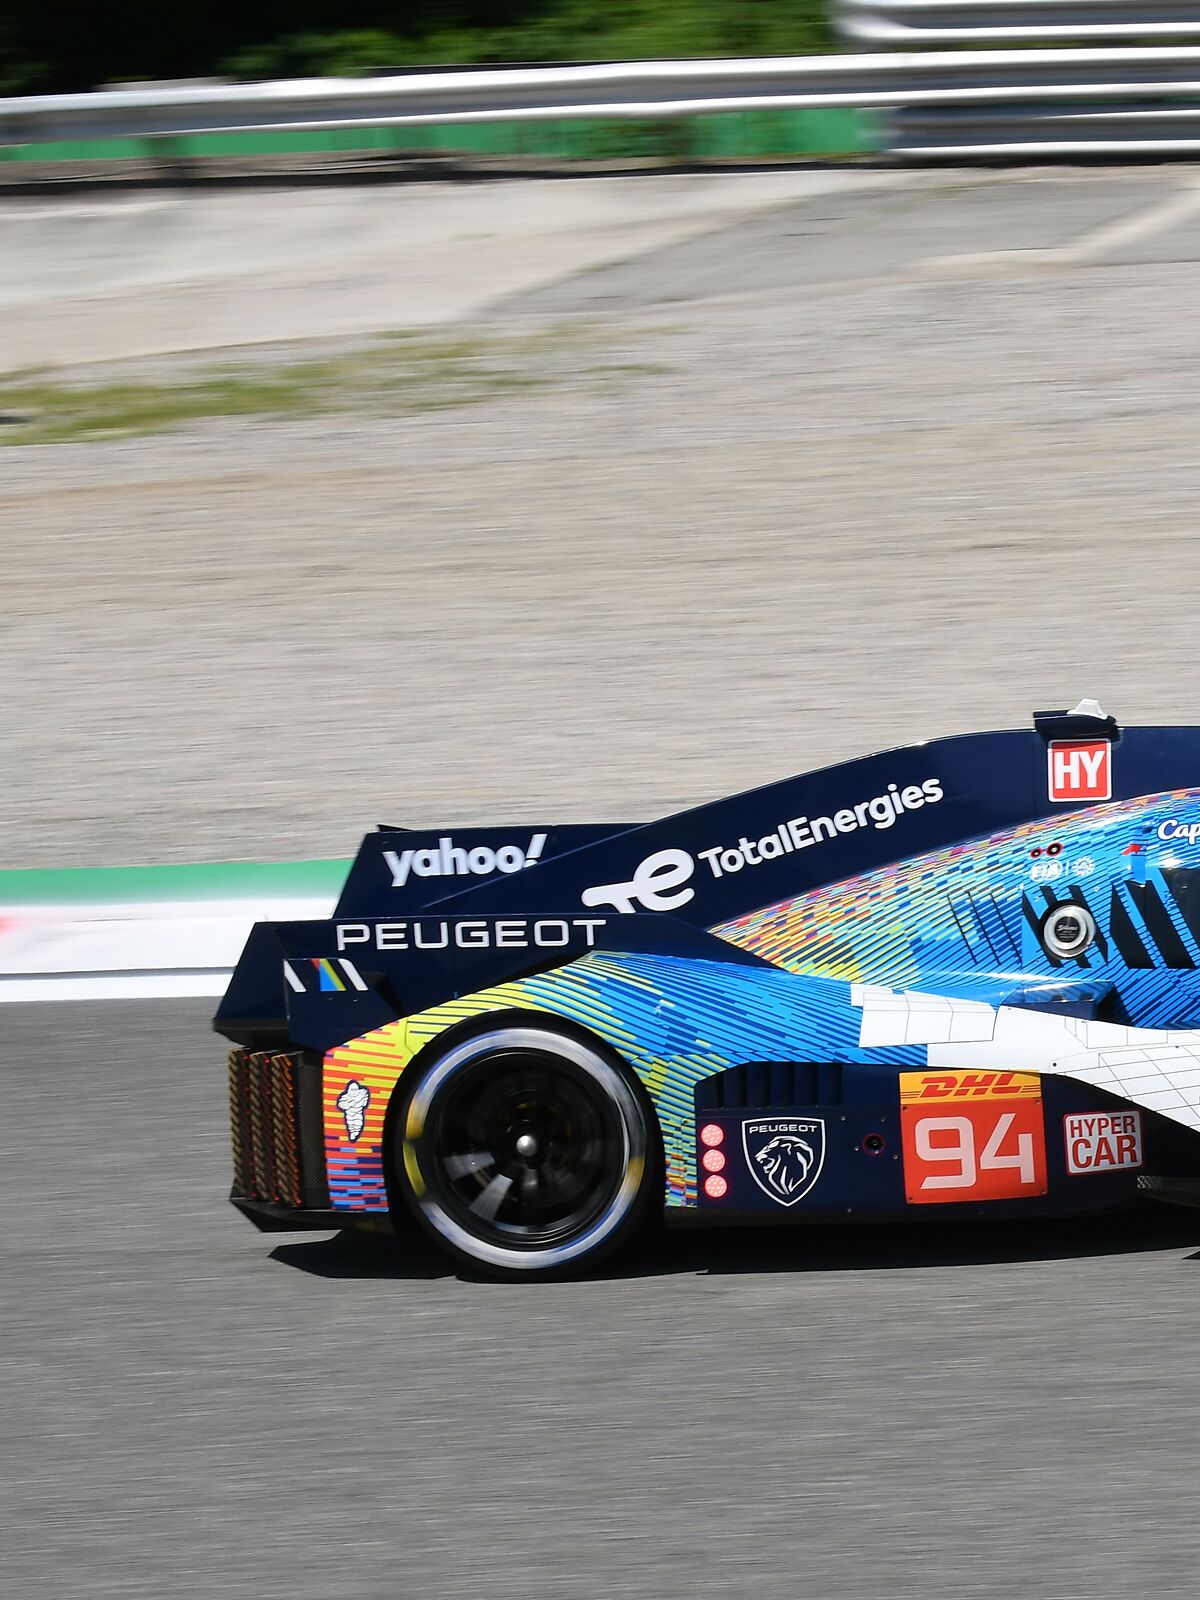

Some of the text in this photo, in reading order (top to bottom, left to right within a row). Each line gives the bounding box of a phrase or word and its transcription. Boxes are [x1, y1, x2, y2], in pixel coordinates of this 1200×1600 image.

[1053, 750, 1103, 789] HY
[698, 778, 944, 878] TotalEnergies
[382, 833, 548, 887] yahoo!
[336, 919, 607, 951] PEUGEOT
[919, 1073, 1025, 1098] DHL
[748, 1124, 818, 1135] PEUGEOT
[1069, 1116, 1136, 1140] HYPER
[914, 1113, 1036, 1190] 94
[1072, 1136, 1139, 1169] CAR
